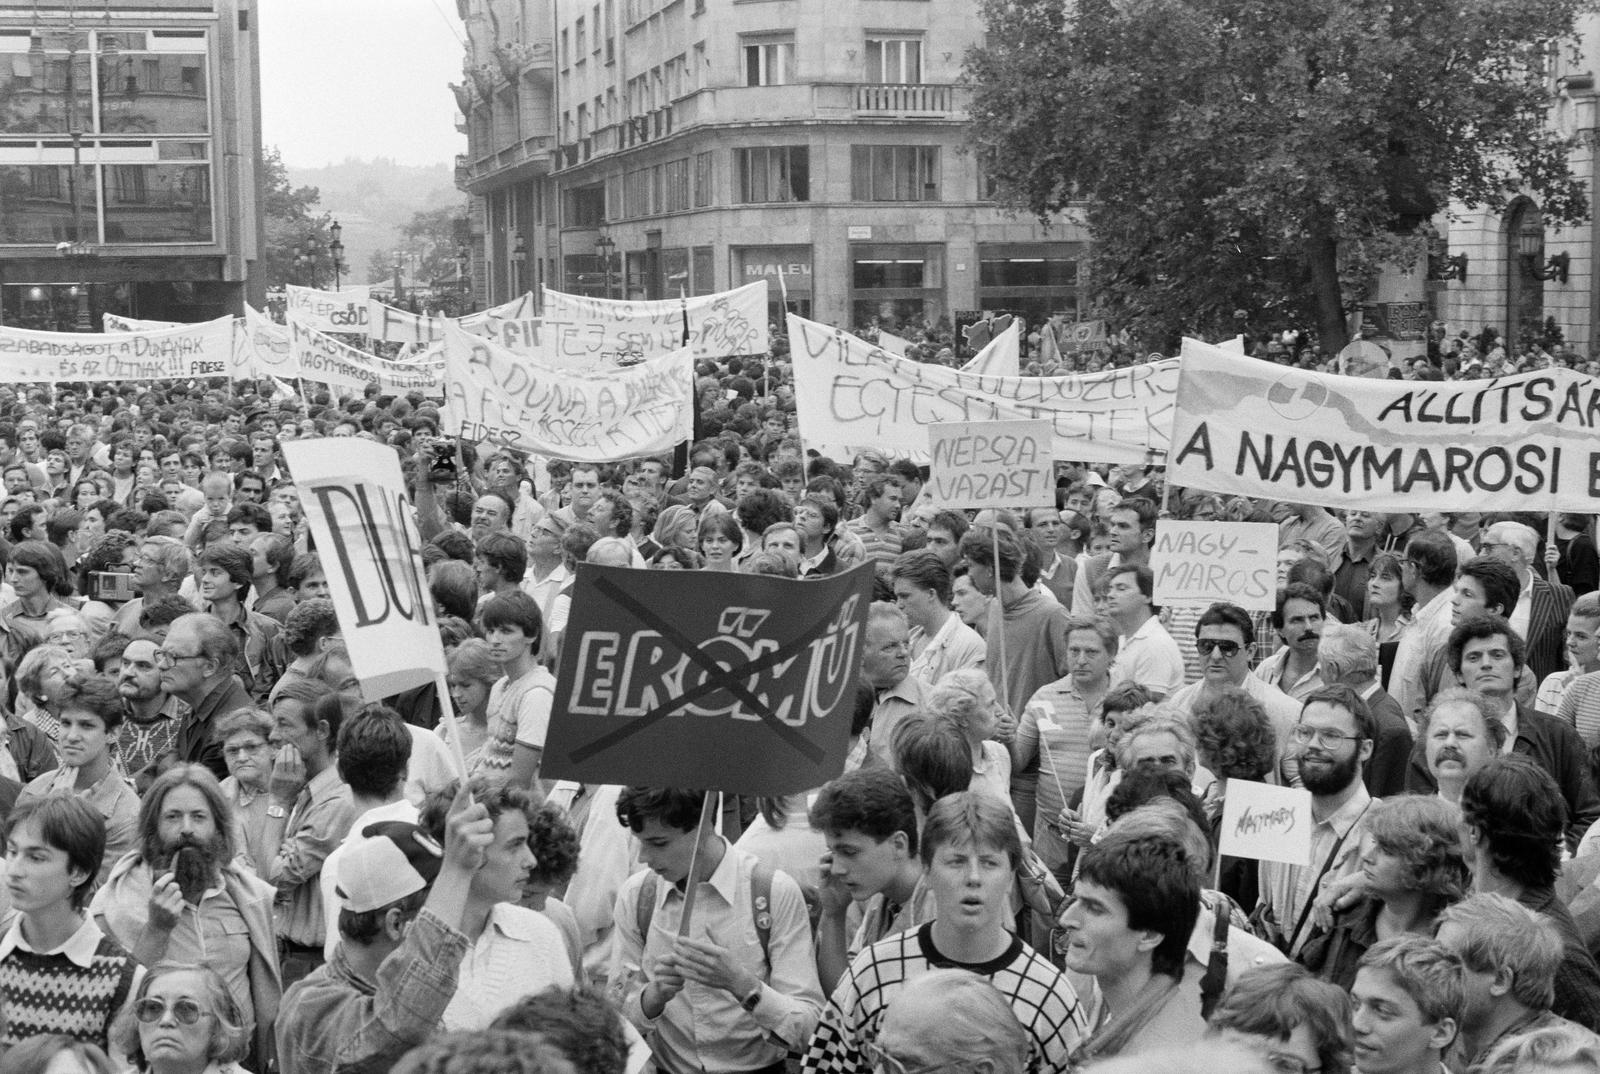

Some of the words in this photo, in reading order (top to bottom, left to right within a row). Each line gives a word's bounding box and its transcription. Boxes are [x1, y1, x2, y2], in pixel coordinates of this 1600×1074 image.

[0, 338, 111, 357] ZABADSÁGOT
[597, 386, 617, 419] A
[1176, 421, 1214, 471] A
[1235, 430, 1562, 496] NAGYMAROSI
[1157, 562, 1270, 599] MAROS
